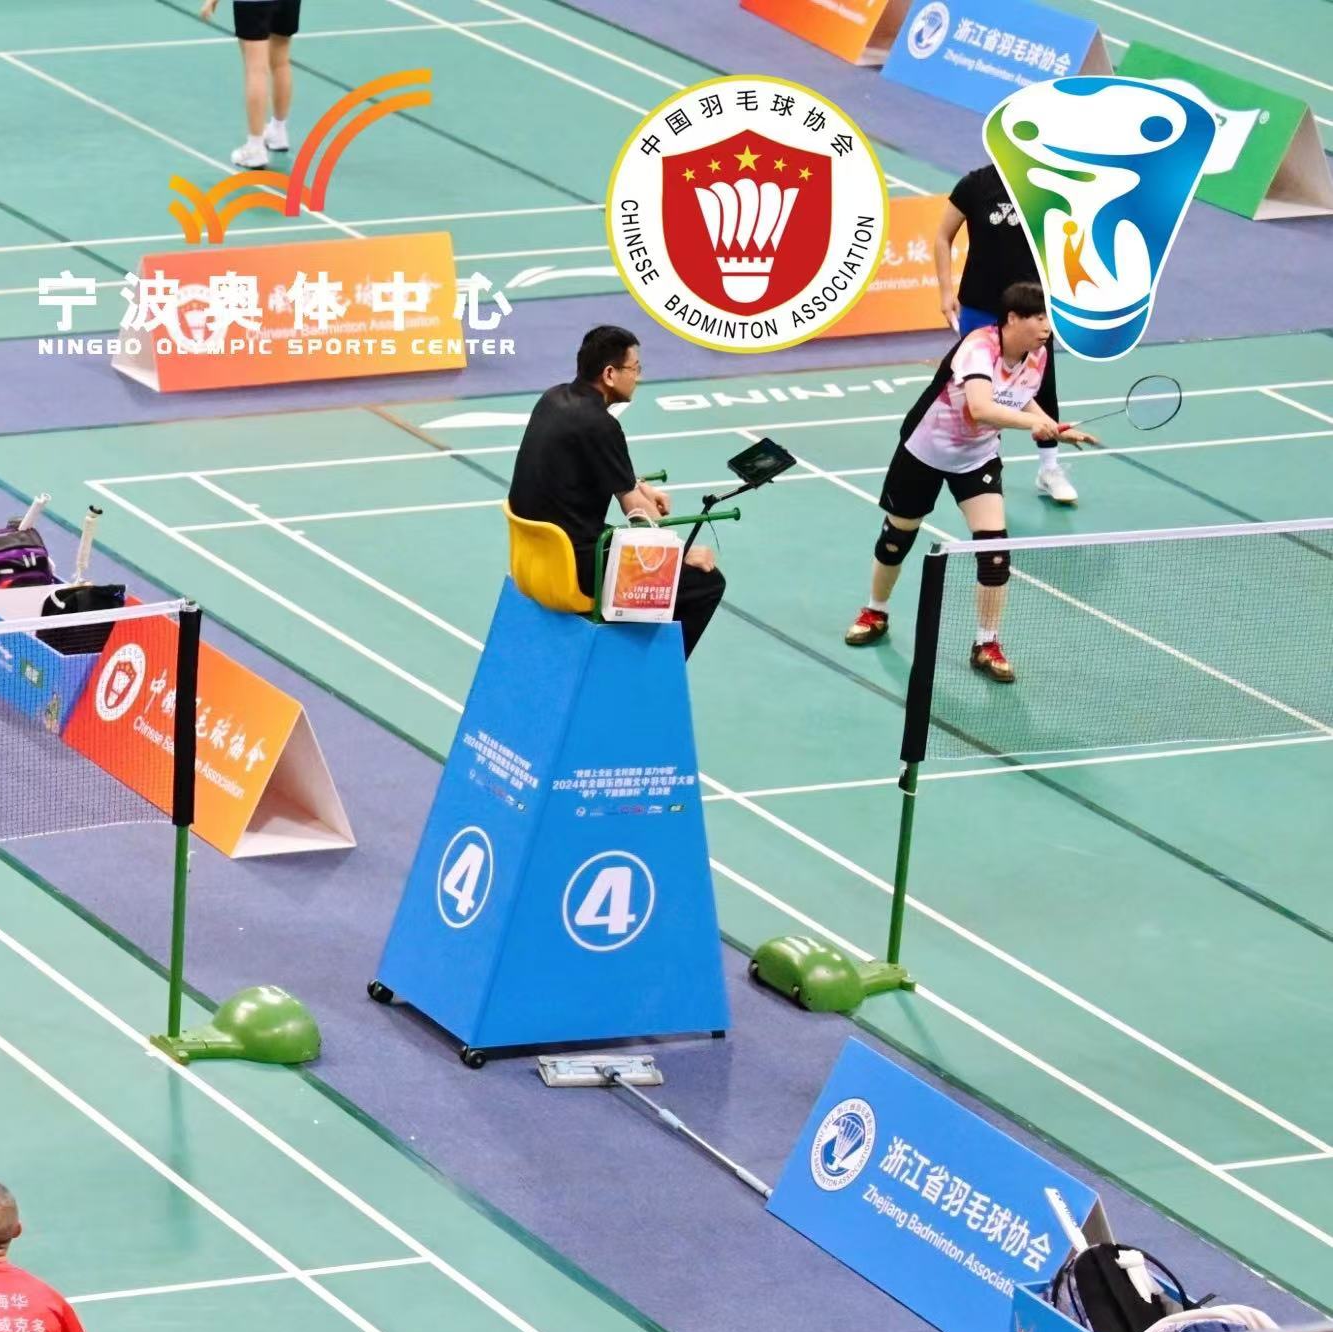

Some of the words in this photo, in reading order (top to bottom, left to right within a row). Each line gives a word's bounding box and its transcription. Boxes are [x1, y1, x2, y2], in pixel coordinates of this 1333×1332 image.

[953, 17, 1071, 76] 浙江省羽毛球协会
[443, 842, 486, 917] 4
[575, 866, 636, 934] 4
[862, 1183, 908, 1229] Zhejiang
[907, 1213, 965, 1264] Badminton
[963, 1252, 1014, 1299] Associati
[879, 1136, 1052, 1272] 浙江省羽毛球协会
